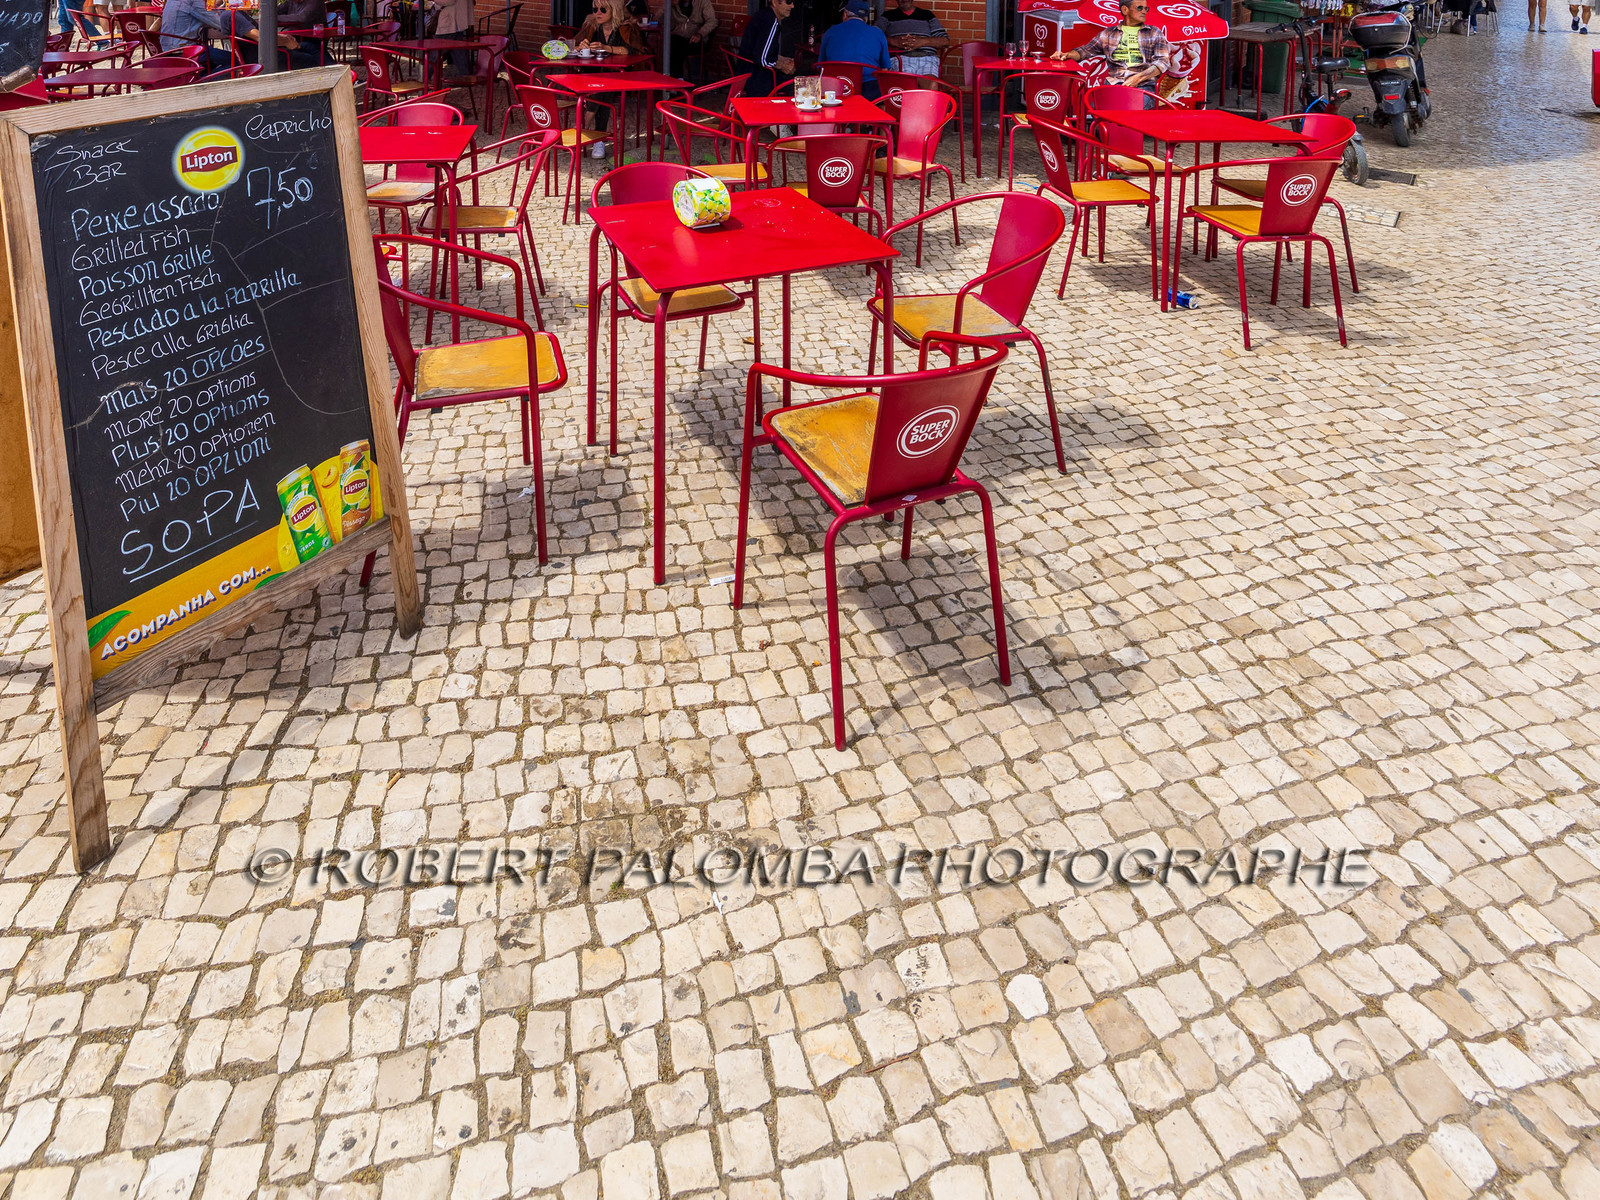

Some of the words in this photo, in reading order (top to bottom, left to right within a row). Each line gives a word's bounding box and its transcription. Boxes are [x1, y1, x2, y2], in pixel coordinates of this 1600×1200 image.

[1194, 24, 1208, 34] OLÁ
[245, 111, 332, 141] Capricho
[45, 138, 138, 172] Snack
[186, 150, 234, 170] Lipton
[1288, 183, 1312, 194] SUPER
[1288, 188, 1310, 197] BOCK
[71, 205, 140, 241] Peixe
[144, 192, 220, 226] assado
[151, 226, 190, 252] Fish
[78, 260, 158, 300] Poisson
[175, 267, 222, 294] Fisch
[87, 308, 180, 352] Pescado
[183, 302, 200, 321] a
[200, 296, 224, 316] la
[91, 345, 150, 380] Pesce
[150, 335, 192, 359] alla
[164, 367, 188, 392] 20
[168, 396, 193, 419] 20
[909, 428, 946, 444] BOCK
[910, 419, 950, 435] SUPER
[111, 435, 160, 468] Plus
[165, 422, 190, 446] 20
[174, 445, 196, 470] 20
[166, 476, 190, 502] 20
[345, 480, 366, 494] Lipton
[293, 504, 315, 522] Lipton
[120, 478, 260, 575] SOPA
[100, 589, 216, 660] ACOMPANHA
[218, 566, 272, 595] COM...
